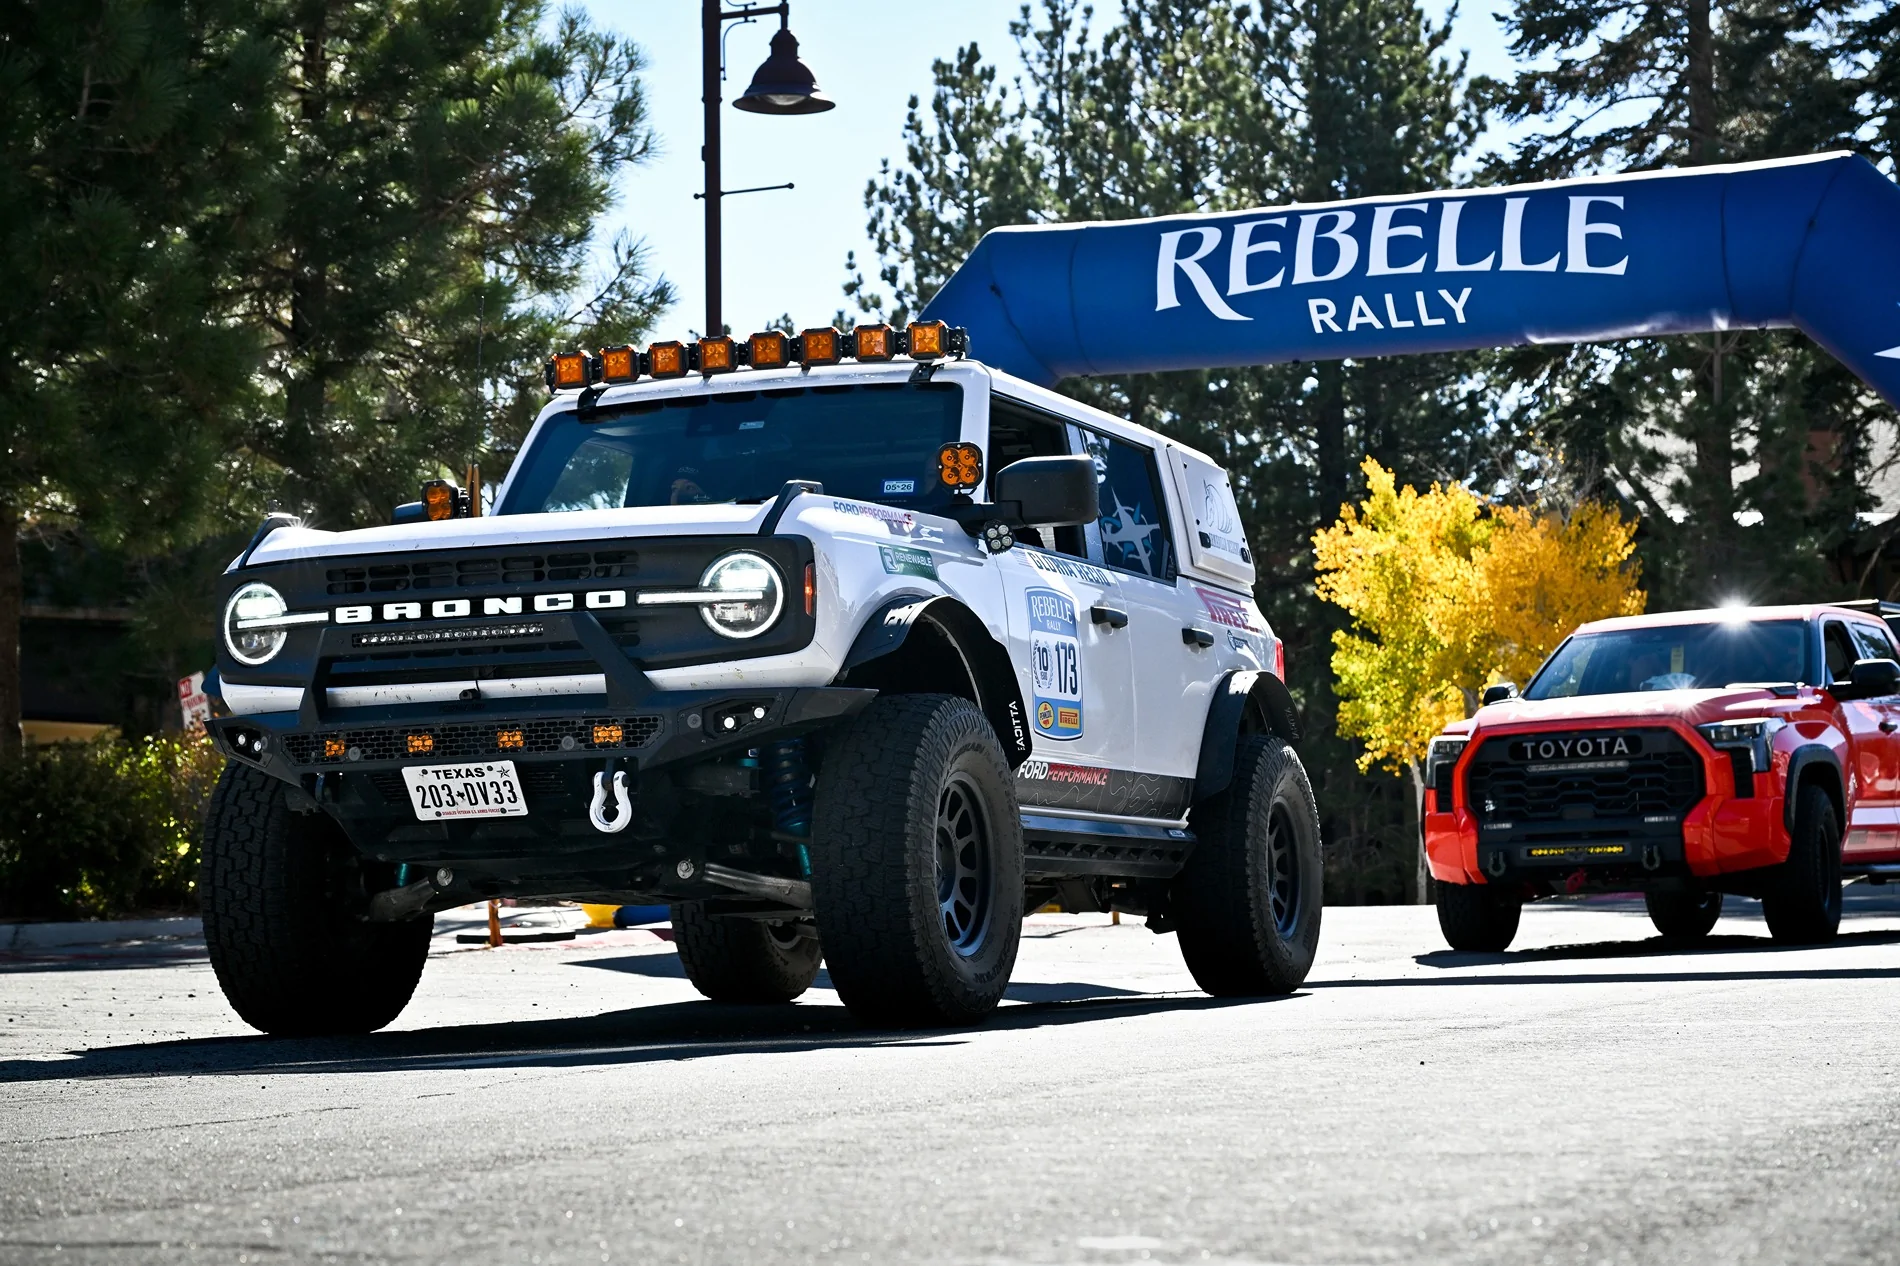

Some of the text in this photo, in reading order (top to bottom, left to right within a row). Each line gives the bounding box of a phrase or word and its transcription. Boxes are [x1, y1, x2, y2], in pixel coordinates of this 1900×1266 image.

[1155, 195, 1629, 321] REBELLE
[1307, 287, 1472, 334] RALLY
[833, 501, 859, 516] FORD
[894, 551, 933, 567] RENEWABLE
[334, 590, 626, 624] BRONCO
[1030, 595, 1073, 624] REBELLE
[1046, 619, 1061, 631] RALLY
[1037, 646, 1049, 672] 10
[1055, 640, 1078, 695] 173
[1059, 711, 1078, 725] PIRELLI
[1522, 737, 1629, 760] TOYOTA
[431, 767, 486, 780] TEXAS
[1017, 760, 1110, 786] FORD PERFORMANCE
